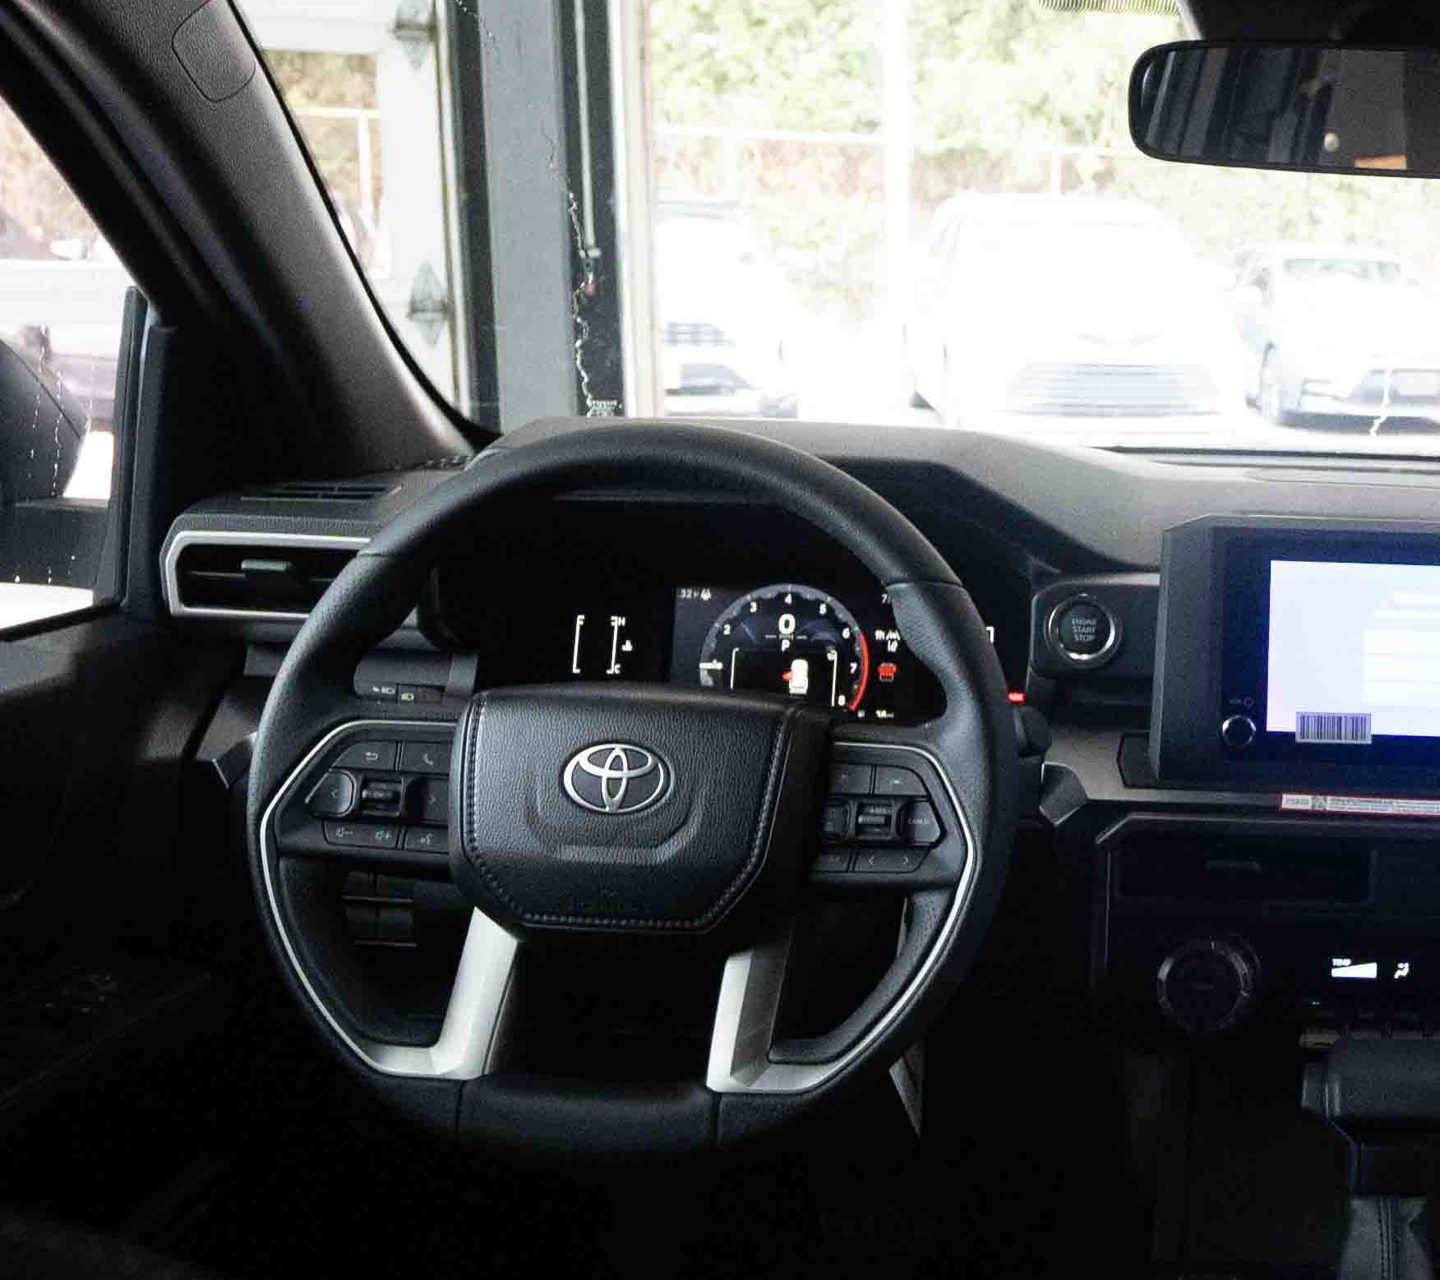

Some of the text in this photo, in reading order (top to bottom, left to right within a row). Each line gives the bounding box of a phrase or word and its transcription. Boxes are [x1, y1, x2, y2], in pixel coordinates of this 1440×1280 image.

[784, 593, 792, 605] 4
[749, 601, 757, 613] 3
[819, 603, 827, 615] 5
[723, 624, 731, 635] 2
[842, 628, 851, 639] 6
[781, 639, 790, 651] P
[849, 663, 858, 674] 7
[838, 695, 846, 706] 8
